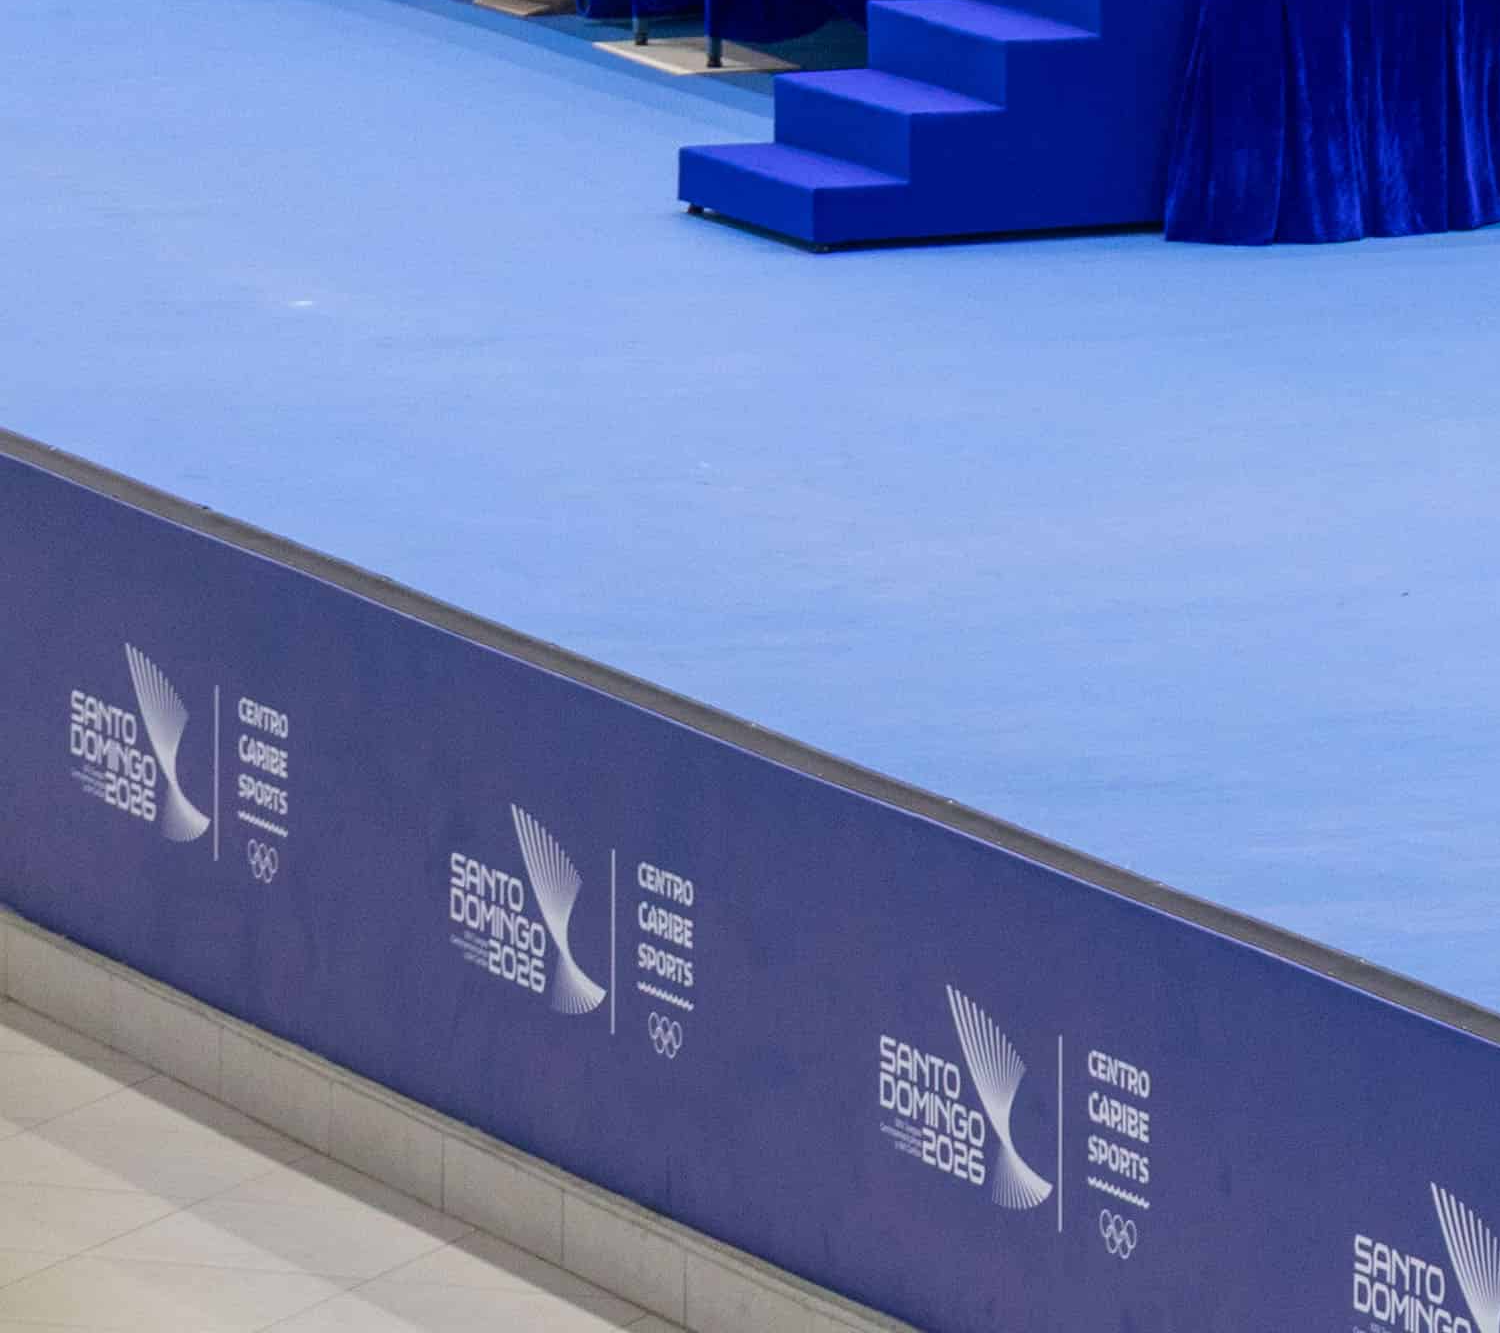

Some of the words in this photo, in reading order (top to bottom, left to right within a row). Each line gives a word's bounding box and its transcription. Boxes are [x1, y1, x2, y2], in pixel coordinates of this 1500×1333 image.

[70, 688, 136, 744] SANTO
[238, 697, 288, 738] CENTRO
[70, 722, 156, 788] DOMINGO
[238, 735, 288, 778] CARIBE
[103, 771, 156, 822] 2026
[238, 774, 288, 815] SPORTS
[450, 852, 524, 913] SANTO
[637, 862, 693, 906] CENTRO
[450, 887, 546, 958] DOMINGO
[637, 901, 693, 949] CARIBE
[488, 938, 546, 994] 2026
[637, 943, 693, 987] SPORTS
[879, 1035, 960, 1100] SANTO
[1088, 1050, 1149, 1098] CENTRO
[879, 1072, 985, 1148] DOMINGO
[1088, 1091, 1149, 1143] CARIBE
[922, 1128, 985, 1185] 2026
[1088, 1135, 1150, 1183] SPORTS
[1353, 1234, 1445, 1304] SANTO
